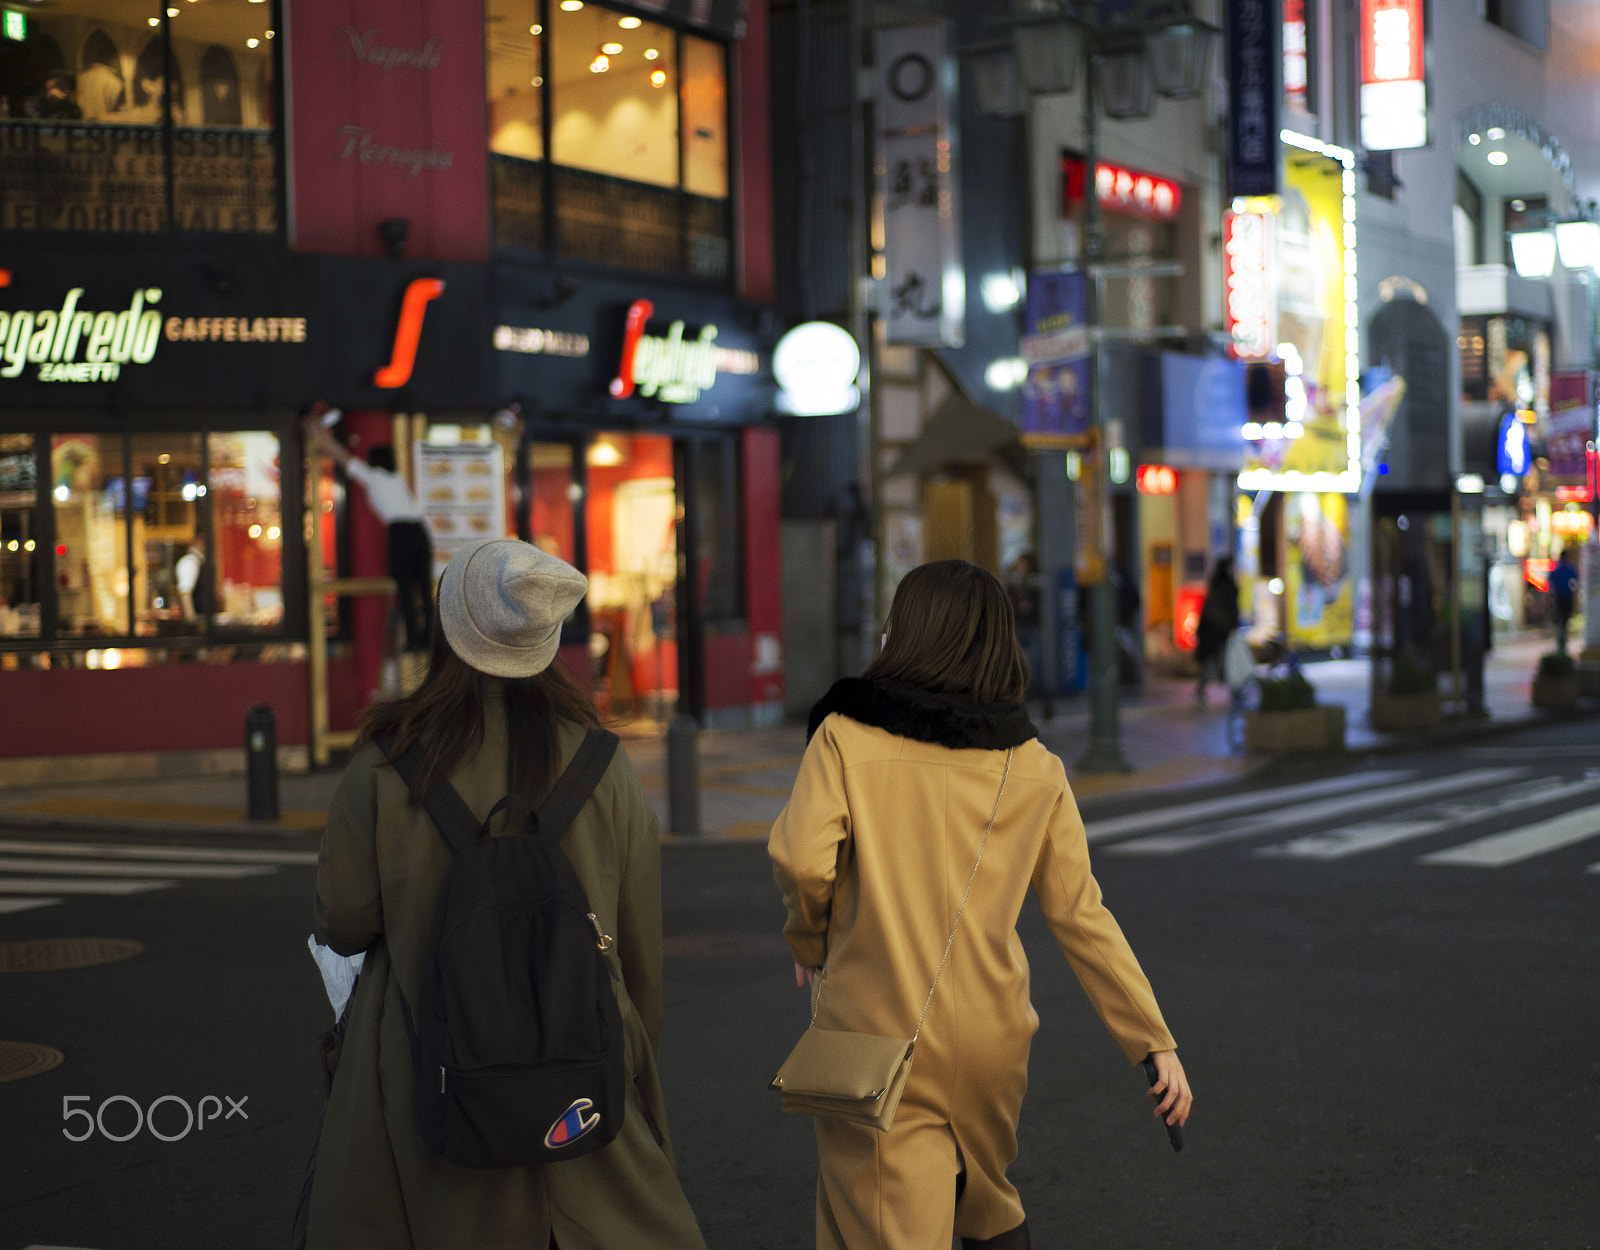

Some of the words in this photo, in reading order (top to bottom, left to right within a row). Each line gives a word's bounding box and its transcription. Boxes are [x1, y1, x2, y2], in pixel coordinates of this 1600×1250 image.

[333, 26, 444, 73] Napoli
[329, 125, 454, 180] Perugia
[164, 316, 307, 342] CAFFELATTE
[38, 362, 120, 382] ZANETTI
